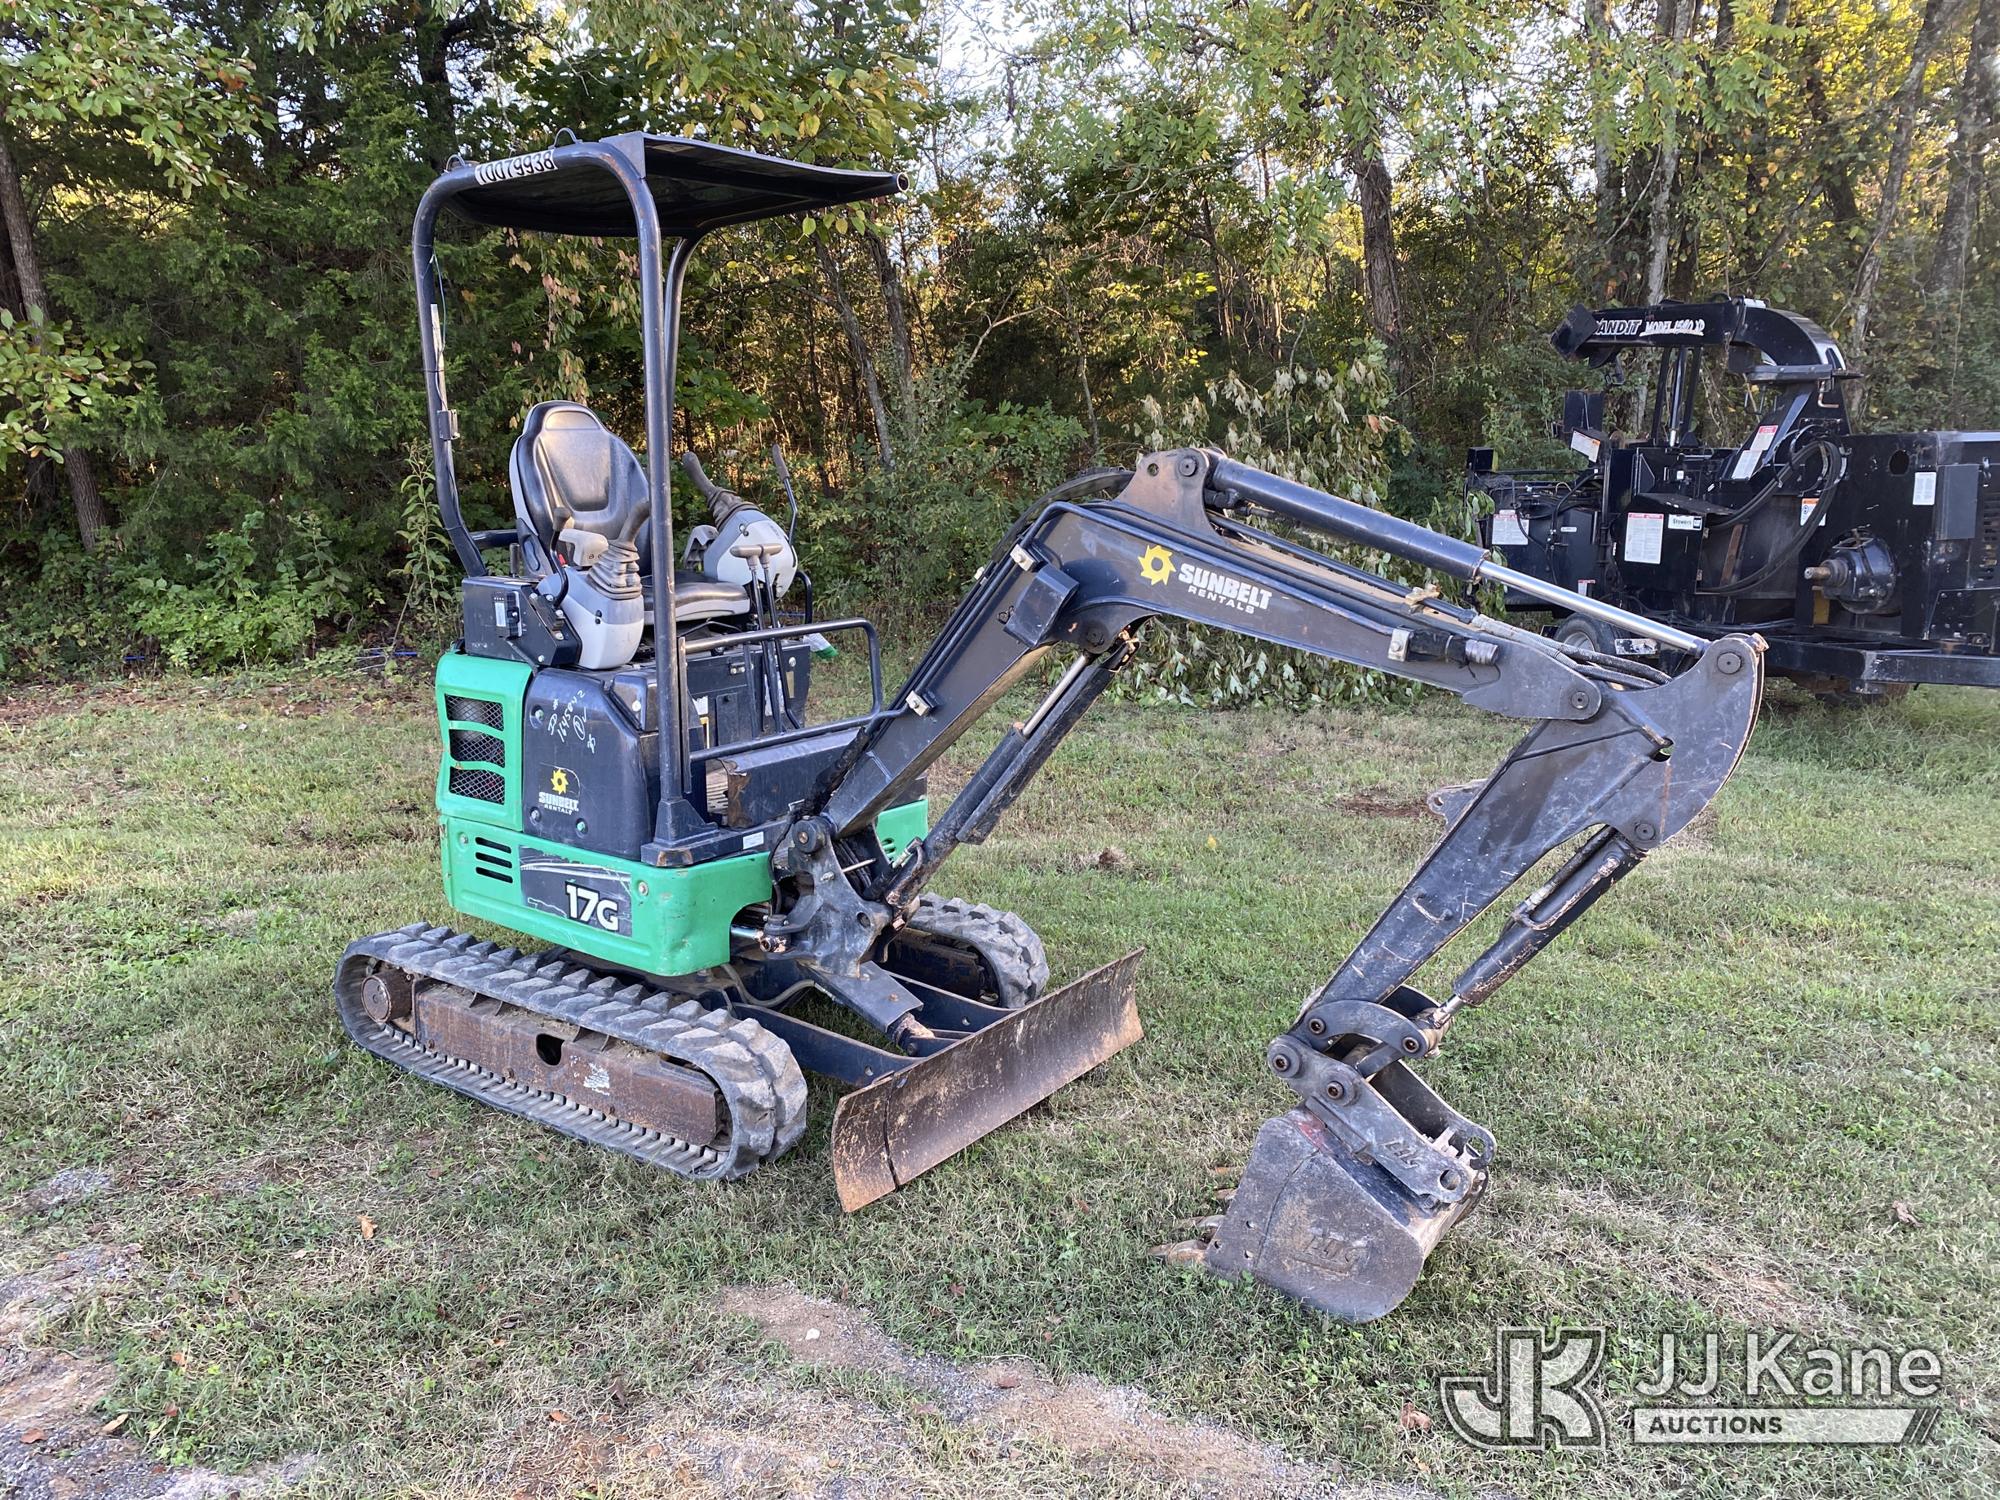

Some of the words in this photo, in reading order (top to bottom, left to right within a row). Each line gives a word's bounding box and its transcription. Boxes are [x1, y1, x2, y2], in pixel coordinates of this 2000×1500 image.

[478, 151, 555, 183] 10079938
[1178, 563, 1273, 610] SUNBELT
[1187, 584, 1255, 615] RENTALS
[538, 791, 580, 812] SUNBELT
[565, 881, 619, 931] 17G
